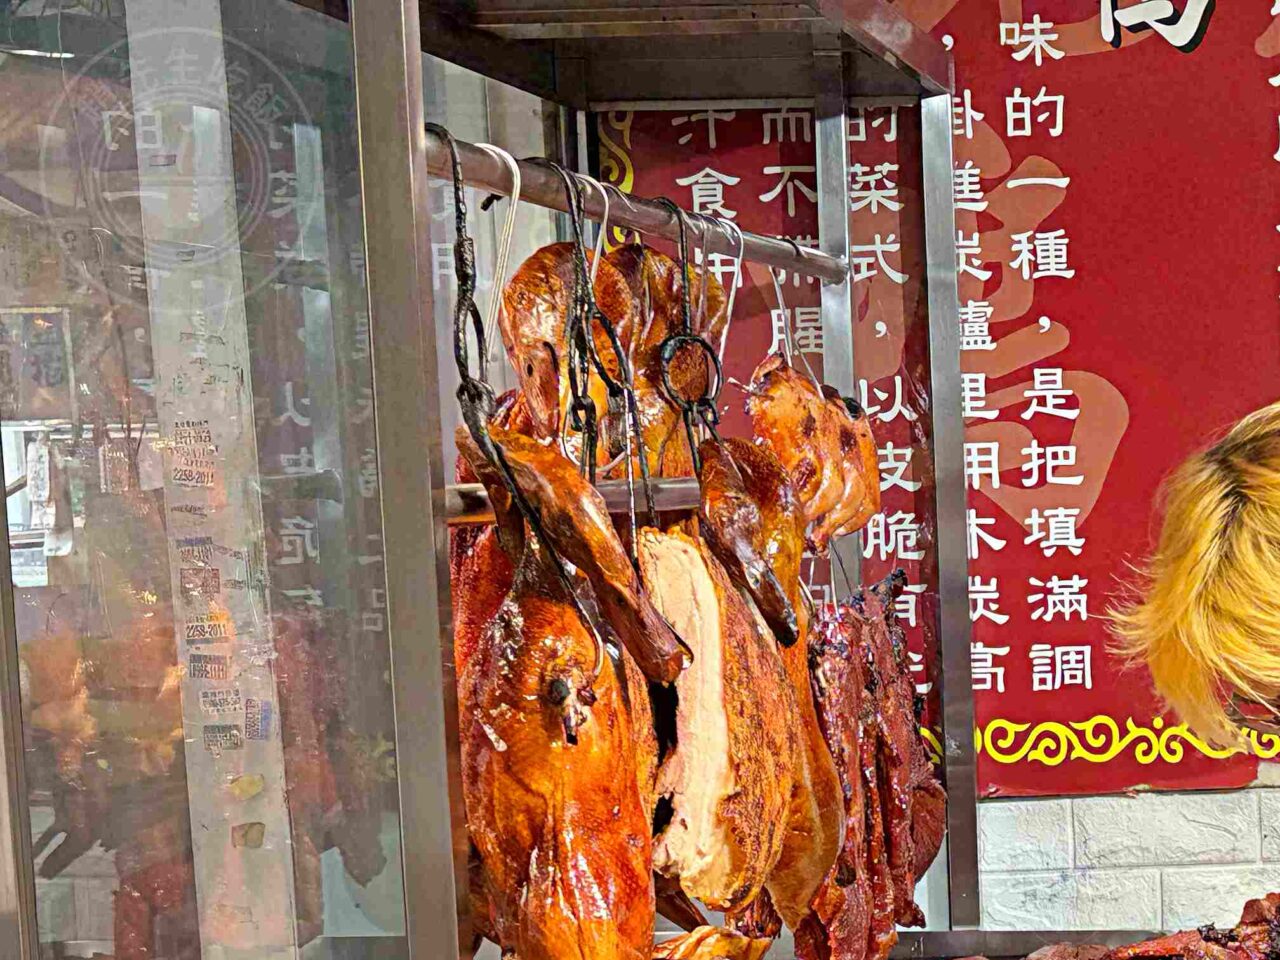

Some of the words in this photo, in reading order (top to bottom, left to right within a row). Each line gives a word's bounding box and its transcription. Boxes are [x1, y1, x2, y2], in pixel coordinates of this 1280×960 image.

[999, 13, 1092, 693] 味的一種，是把填滿調
